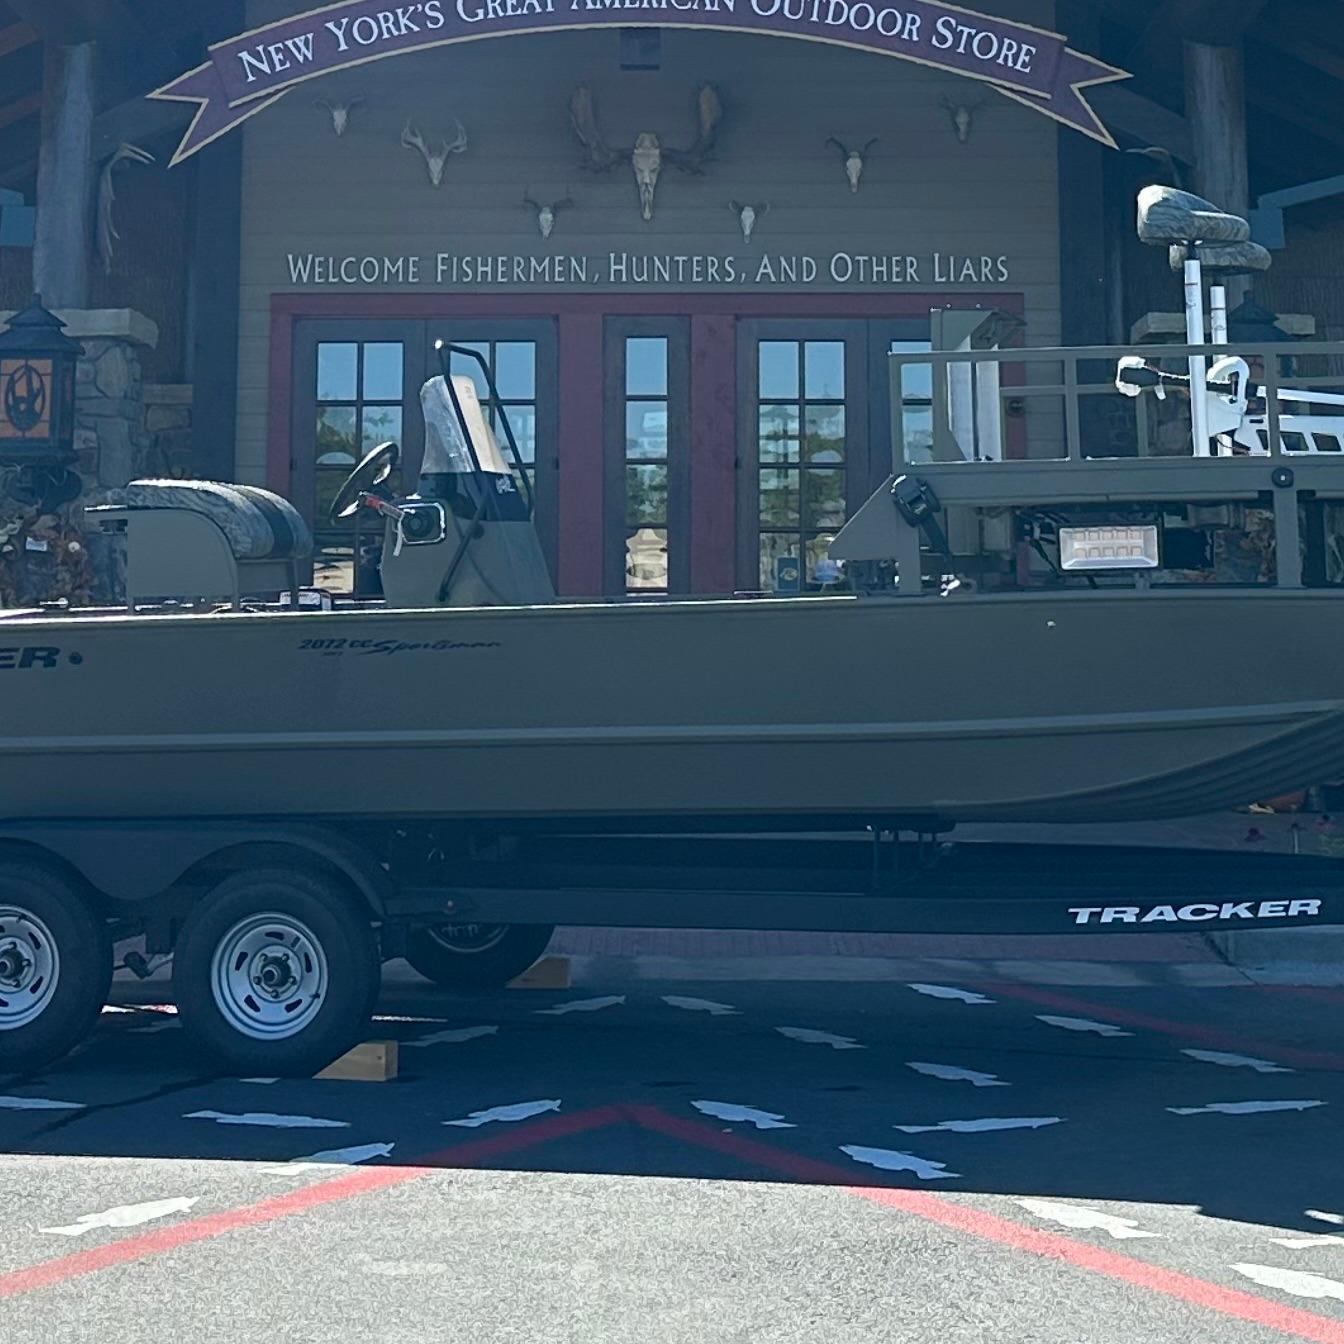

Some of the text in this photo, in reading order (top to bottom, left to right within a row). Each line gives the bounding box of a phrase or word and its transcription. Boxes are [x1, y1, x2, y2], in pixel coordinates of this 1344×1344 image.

[237, 32, 315, 83] NEW
[324, 0, 446, 52] YORK'S
[931, 16, 1037, 74] STORE
[287, 251, 1009, 284] WELCOME FISHERMEN, HUNTERS, AND OTHER LIARS
[1067, 898, 1323, 925] TRACKER
